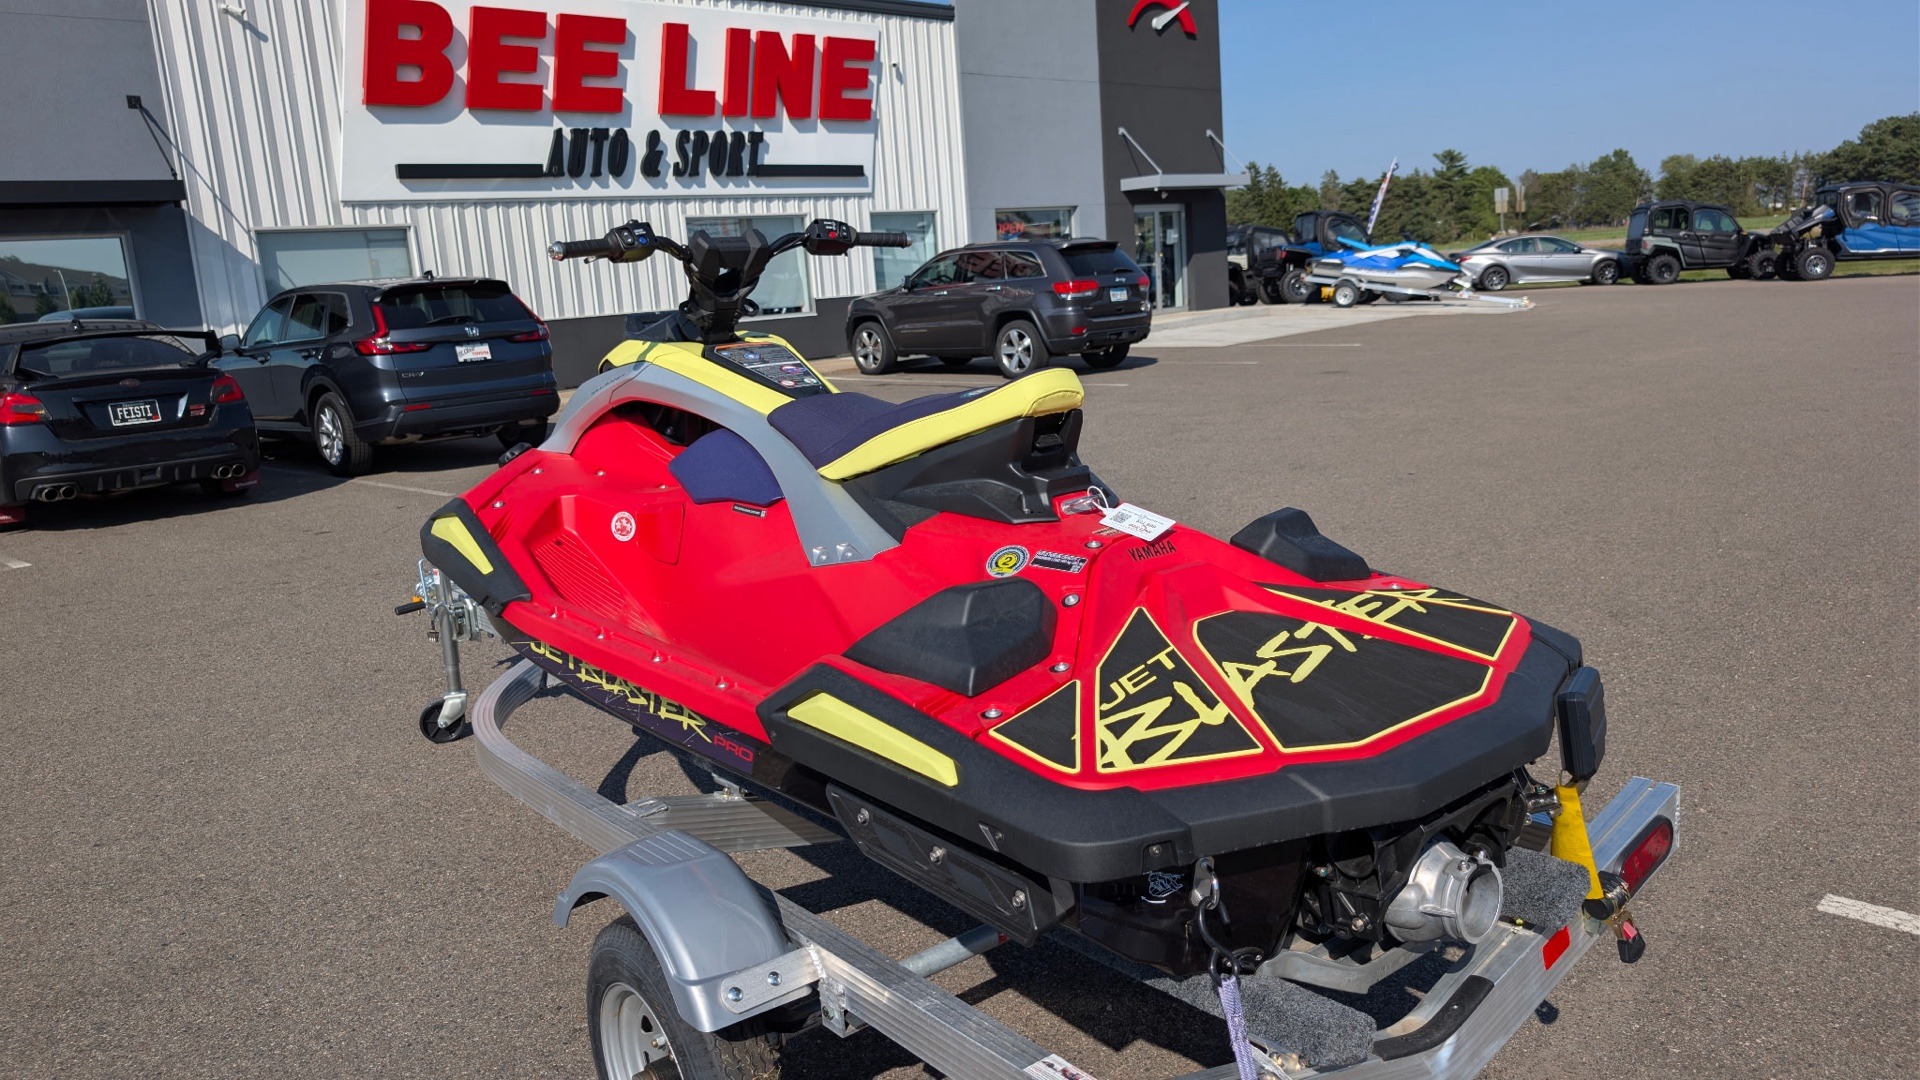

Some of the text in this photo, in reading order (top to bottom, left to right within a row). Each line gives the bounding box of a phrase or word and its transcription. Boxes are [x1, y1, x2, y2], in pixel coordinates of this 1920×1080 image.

[363, 0, 876, 120] BEE LINE
[544, 127, 764, 178] AUTO & SPORT
[116, 405, 153, 420] FEISTI
[1002, 556, 1013, 566] 2
[1127, 540, 1177, 561] YAMAHA
[1099, 646, 1176, 711] JET
[713, 735, 754, 763] PRO
